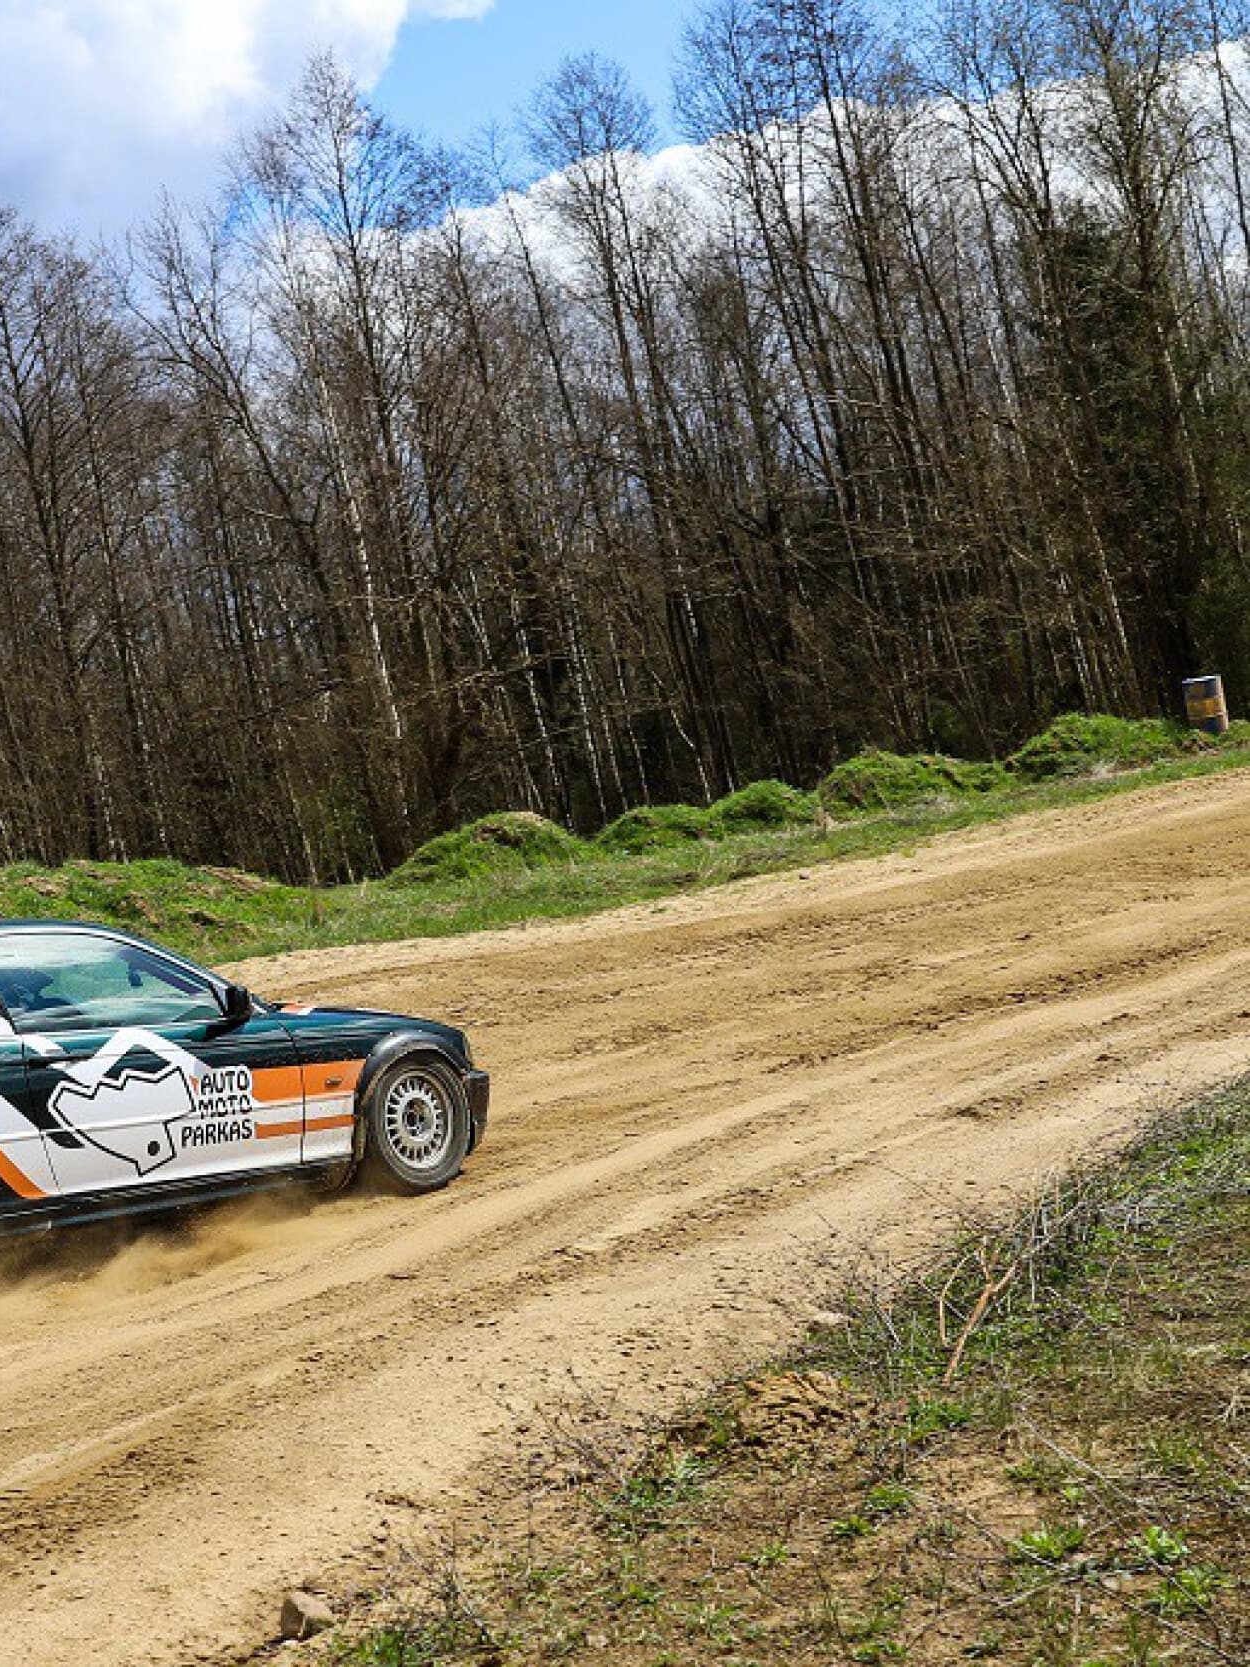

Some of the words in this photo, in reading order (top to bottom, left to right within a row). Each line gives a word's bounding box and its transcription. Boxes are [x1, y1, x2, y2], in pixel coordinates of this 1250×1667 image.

[200, 1070, 249, 1095] AUTO
[198, 1094, 252, 1119] MOTO
[181, 1119, 252, 1148] PARKAS
